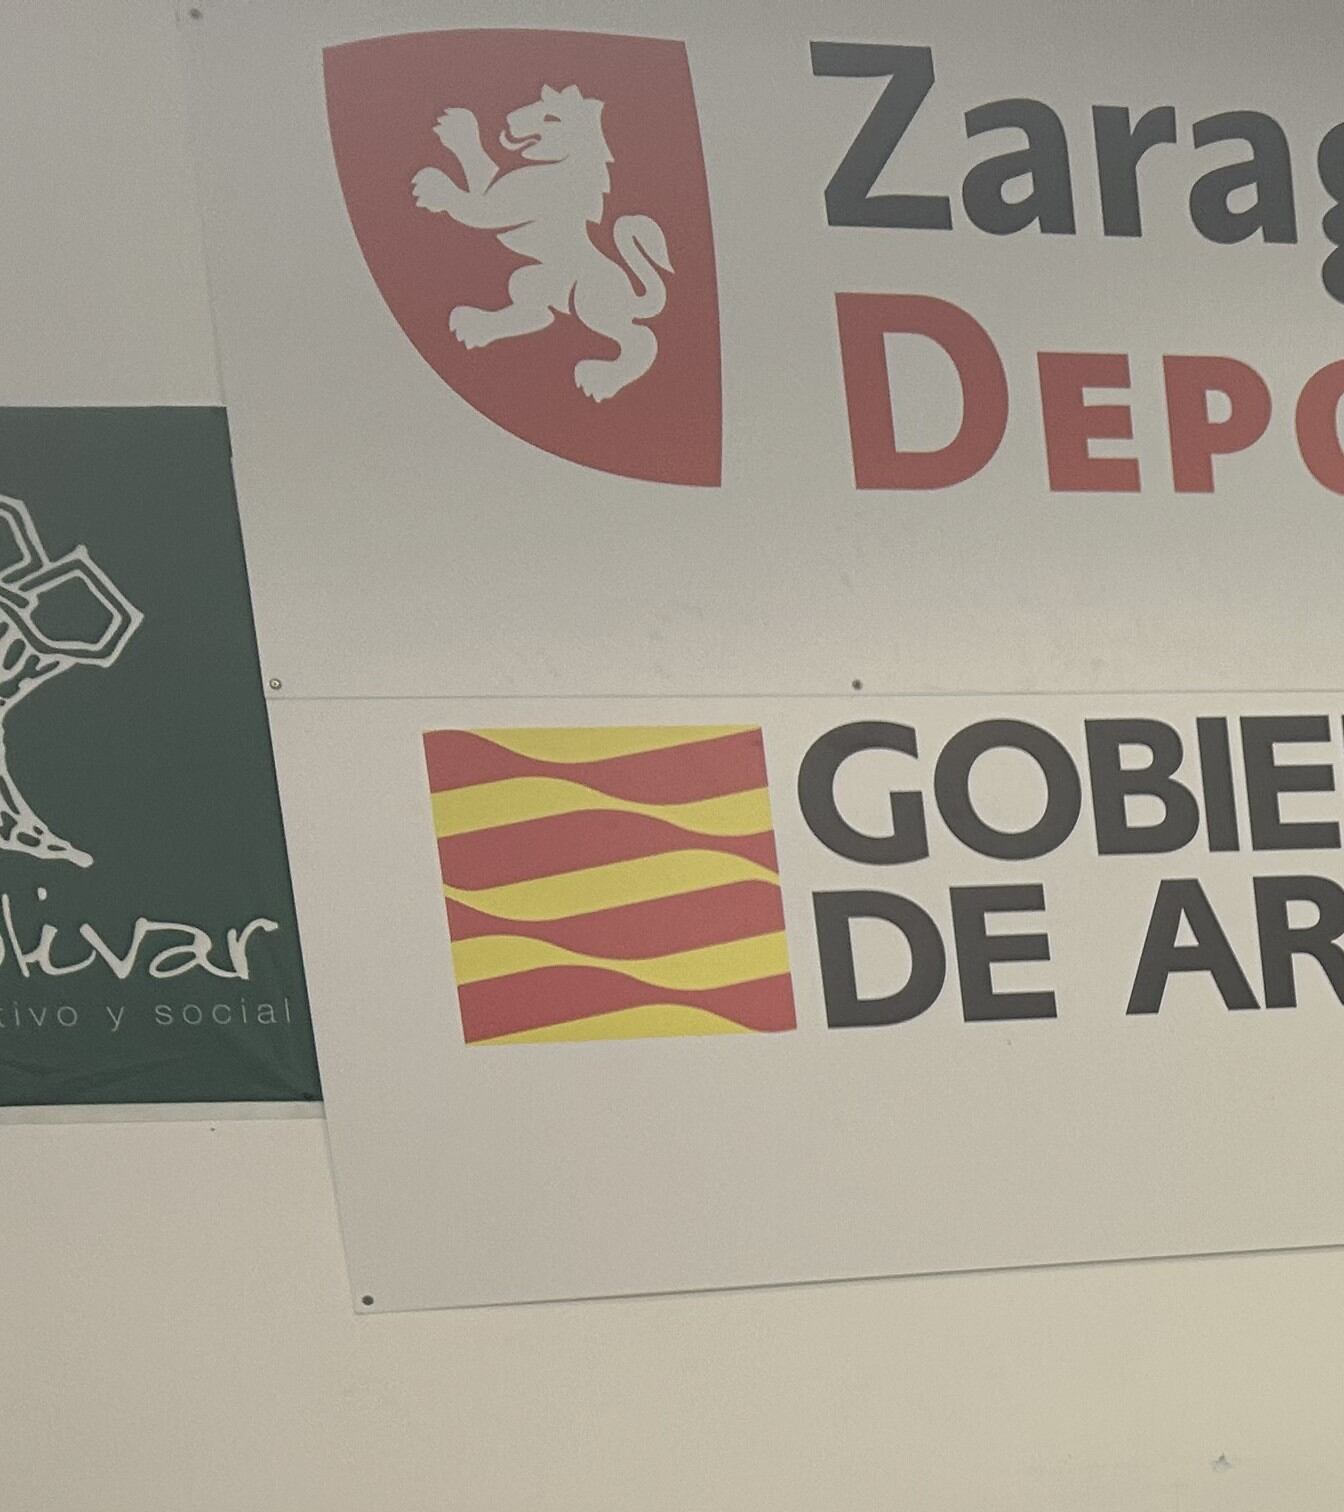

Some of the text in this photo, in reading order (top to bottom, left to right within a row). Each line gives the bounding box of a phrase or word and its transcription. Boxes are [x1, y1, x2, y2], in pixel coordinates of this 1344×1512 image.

[0, 886, 278, 979] livar
[810, 882, 1058, 1031] DE
[107, 1006, 124, 1032] y
[155, 998, 290, 1026] social
